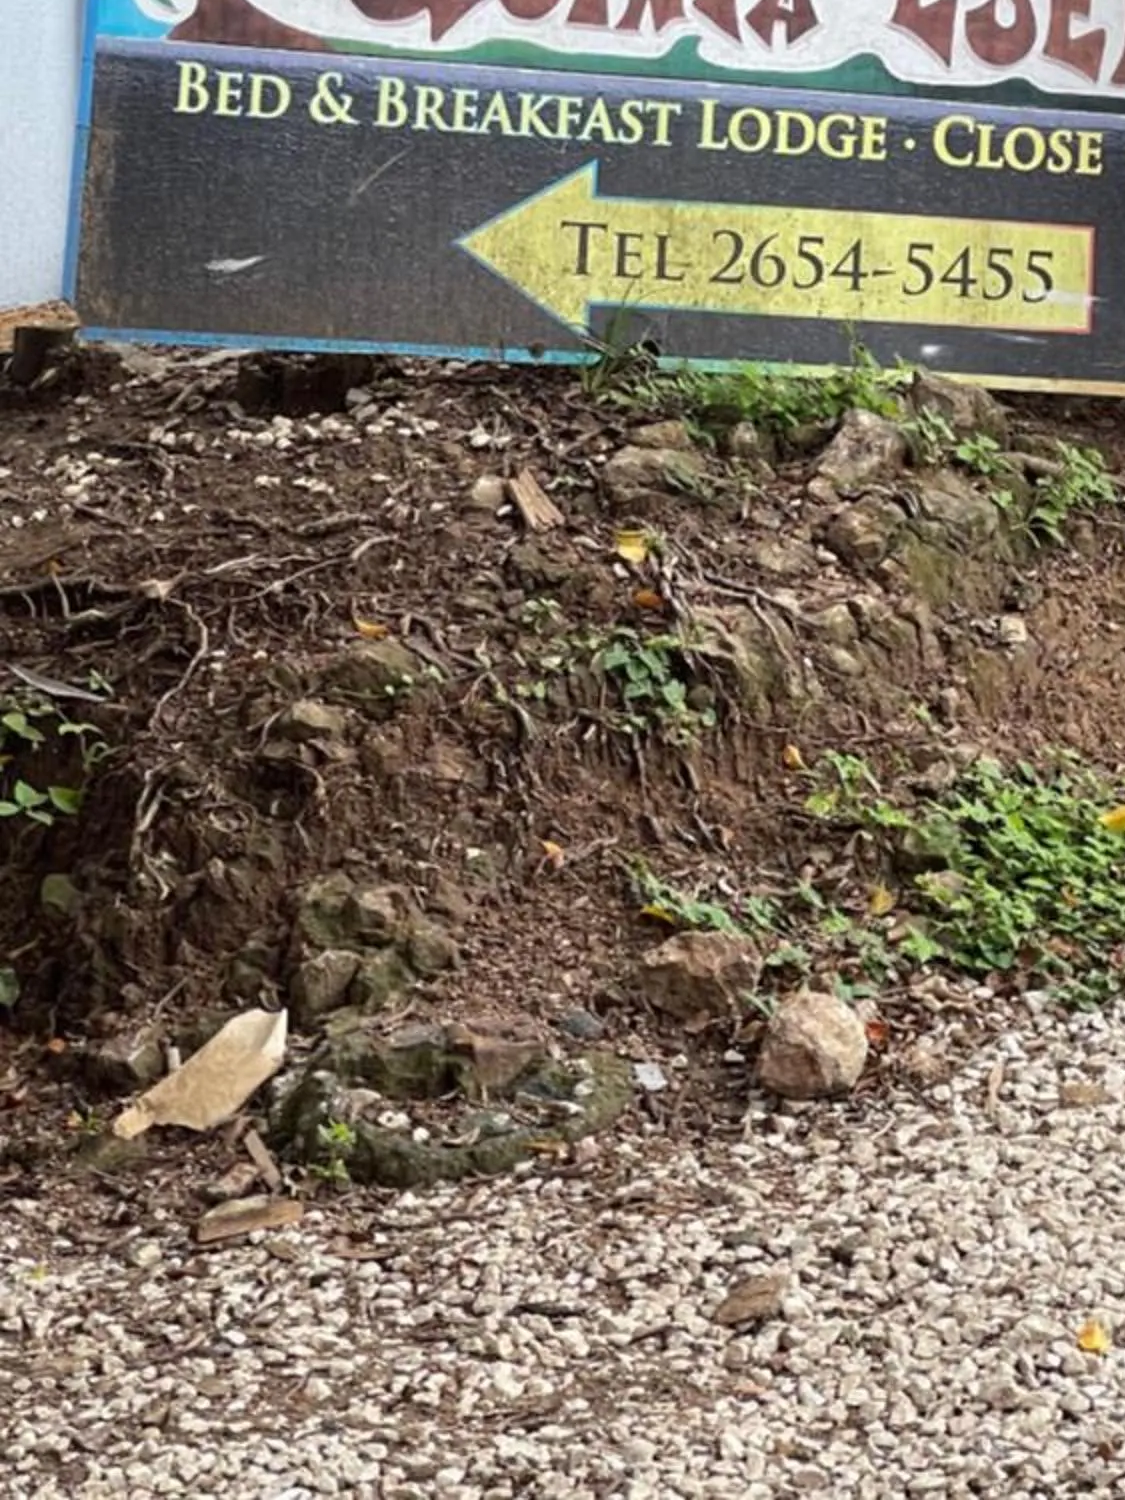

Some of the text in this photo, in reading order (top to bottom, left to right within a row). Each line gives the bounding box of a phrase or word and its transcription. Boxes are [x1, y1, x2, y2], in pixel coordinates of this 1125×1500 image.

[174, 61, 291, 118] BED
[309, 76, 358, 126] &
[376, 78, 682, 148] BREAKFAST
[697, 99, 887, 162] LODGE
[933, 114, 1102, 176] CLOSE
[560, 220, 1056, 304] TEL 2654-5455
